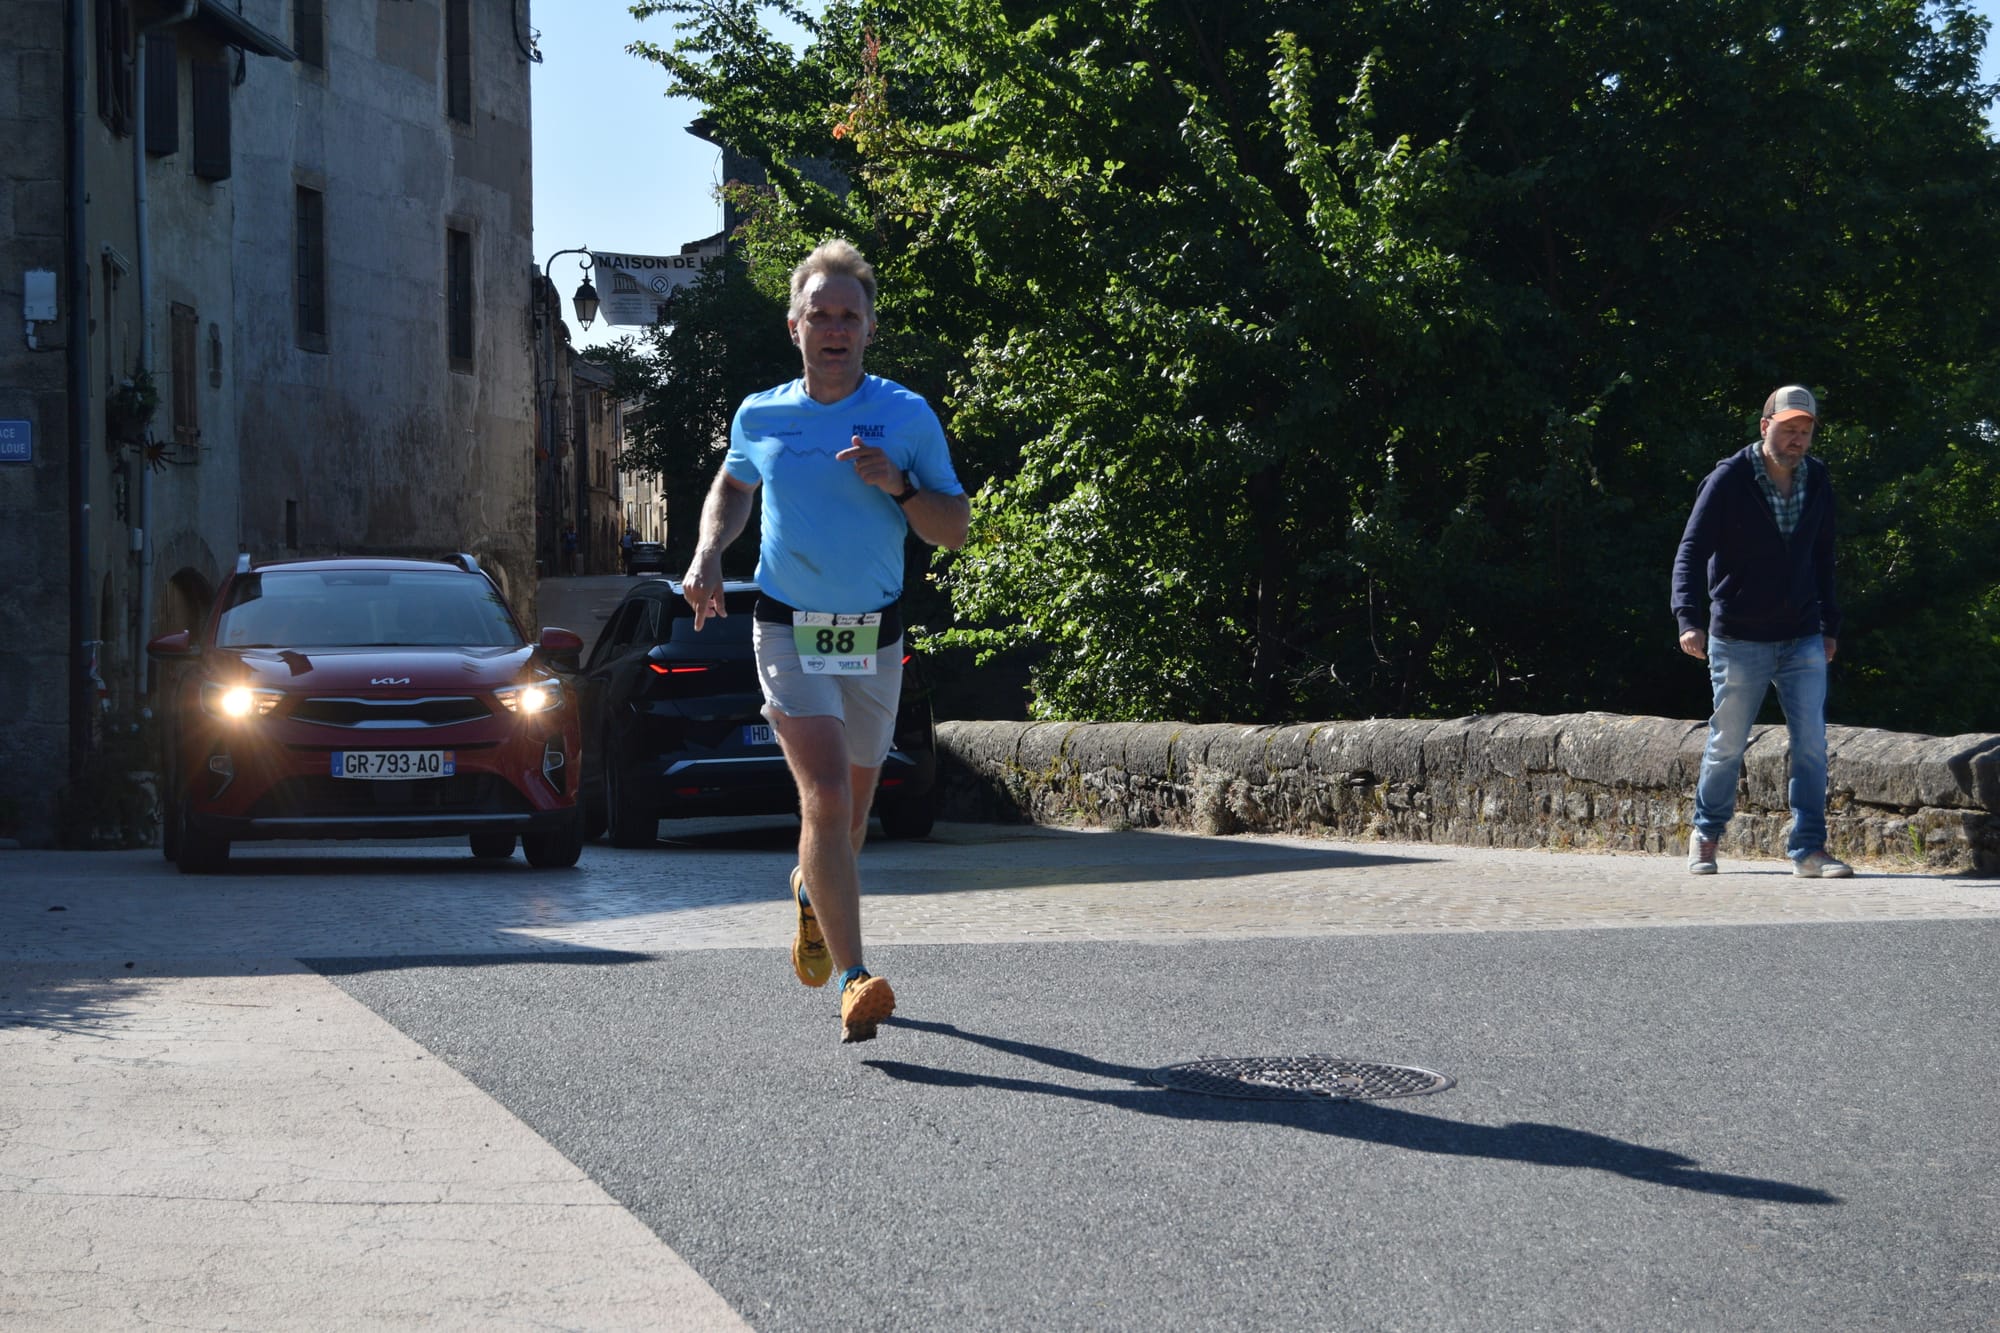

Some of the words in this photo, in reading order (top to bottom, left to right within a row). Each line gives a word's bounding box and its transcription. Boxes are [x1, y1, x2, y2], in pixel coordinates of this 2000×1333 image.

[598, 256, 668, 270] MAISON
[673, 256, 696, 268] DE
[1, 443, 26, 454] LOUE
[816, 629, 855, 654] 88
[371, 677, 411, 685] KIA
[345, 753, 440, 774] GR-793-AQ
